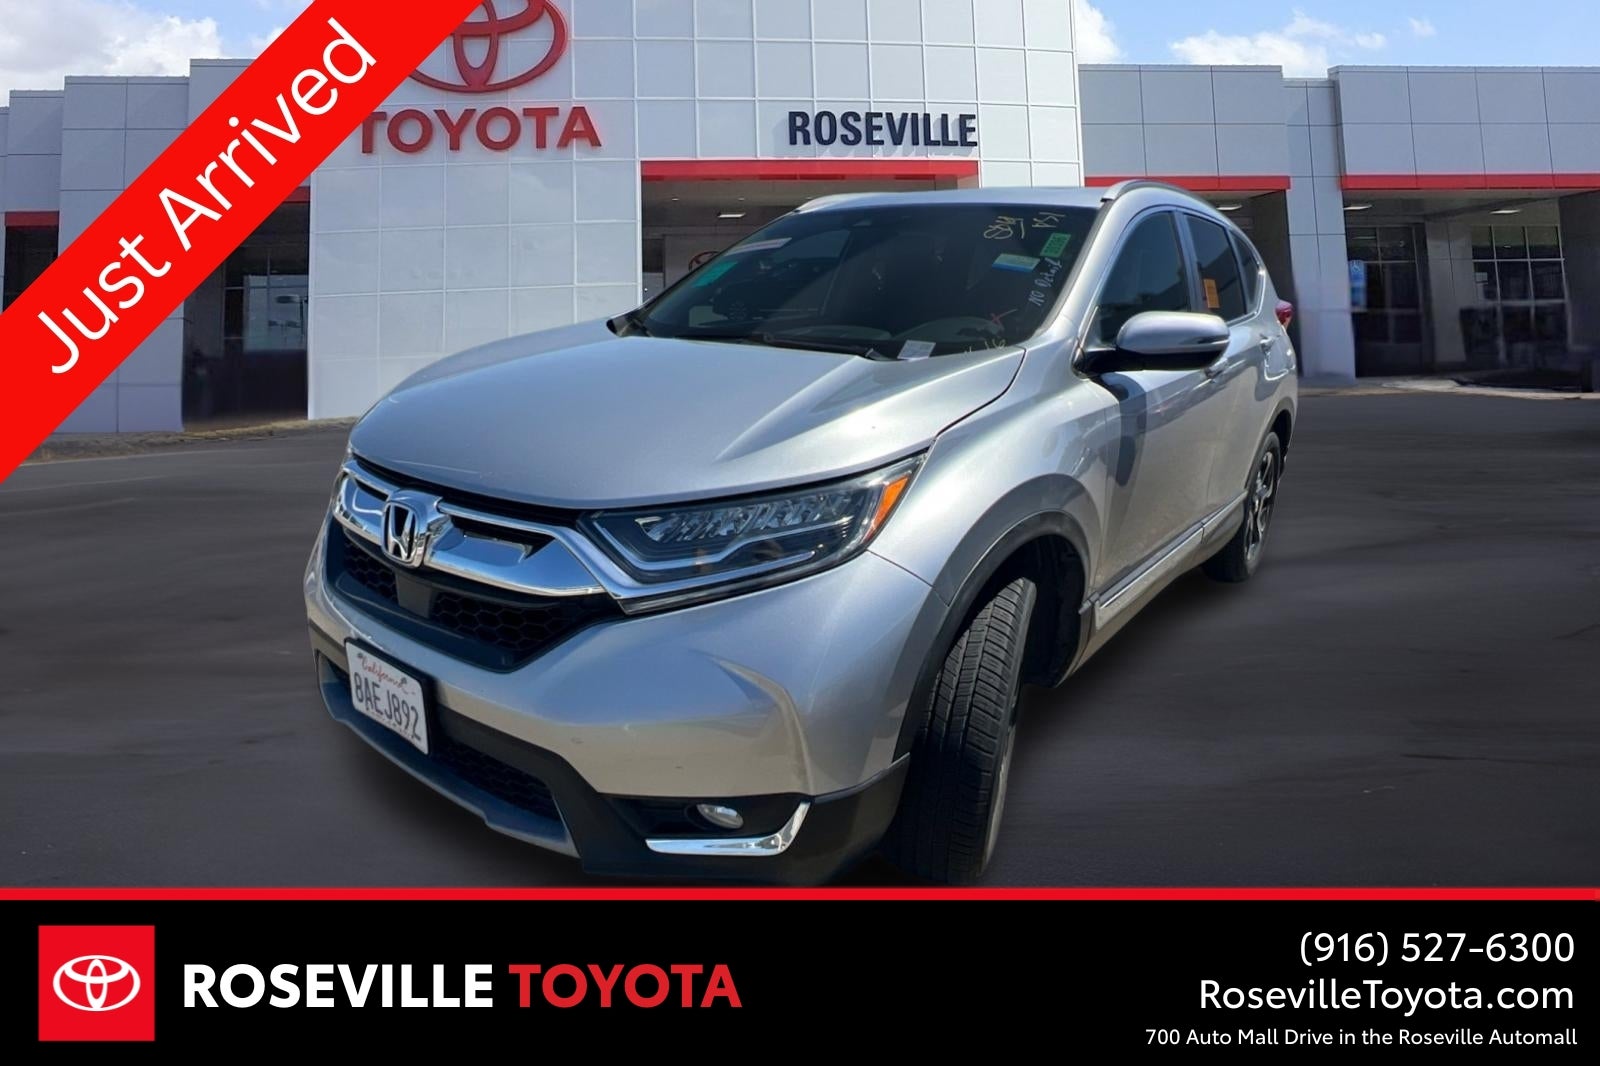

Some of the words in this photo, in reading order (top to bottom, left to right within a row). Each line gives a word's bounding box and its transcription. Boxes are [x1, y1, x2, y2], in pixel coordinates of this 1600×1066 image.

[361, 106, 602, 153] TOYOTA
[788, 110, 978, 147] ROSEVILLE
[354, 672, 422, 741] 8AEJ892
